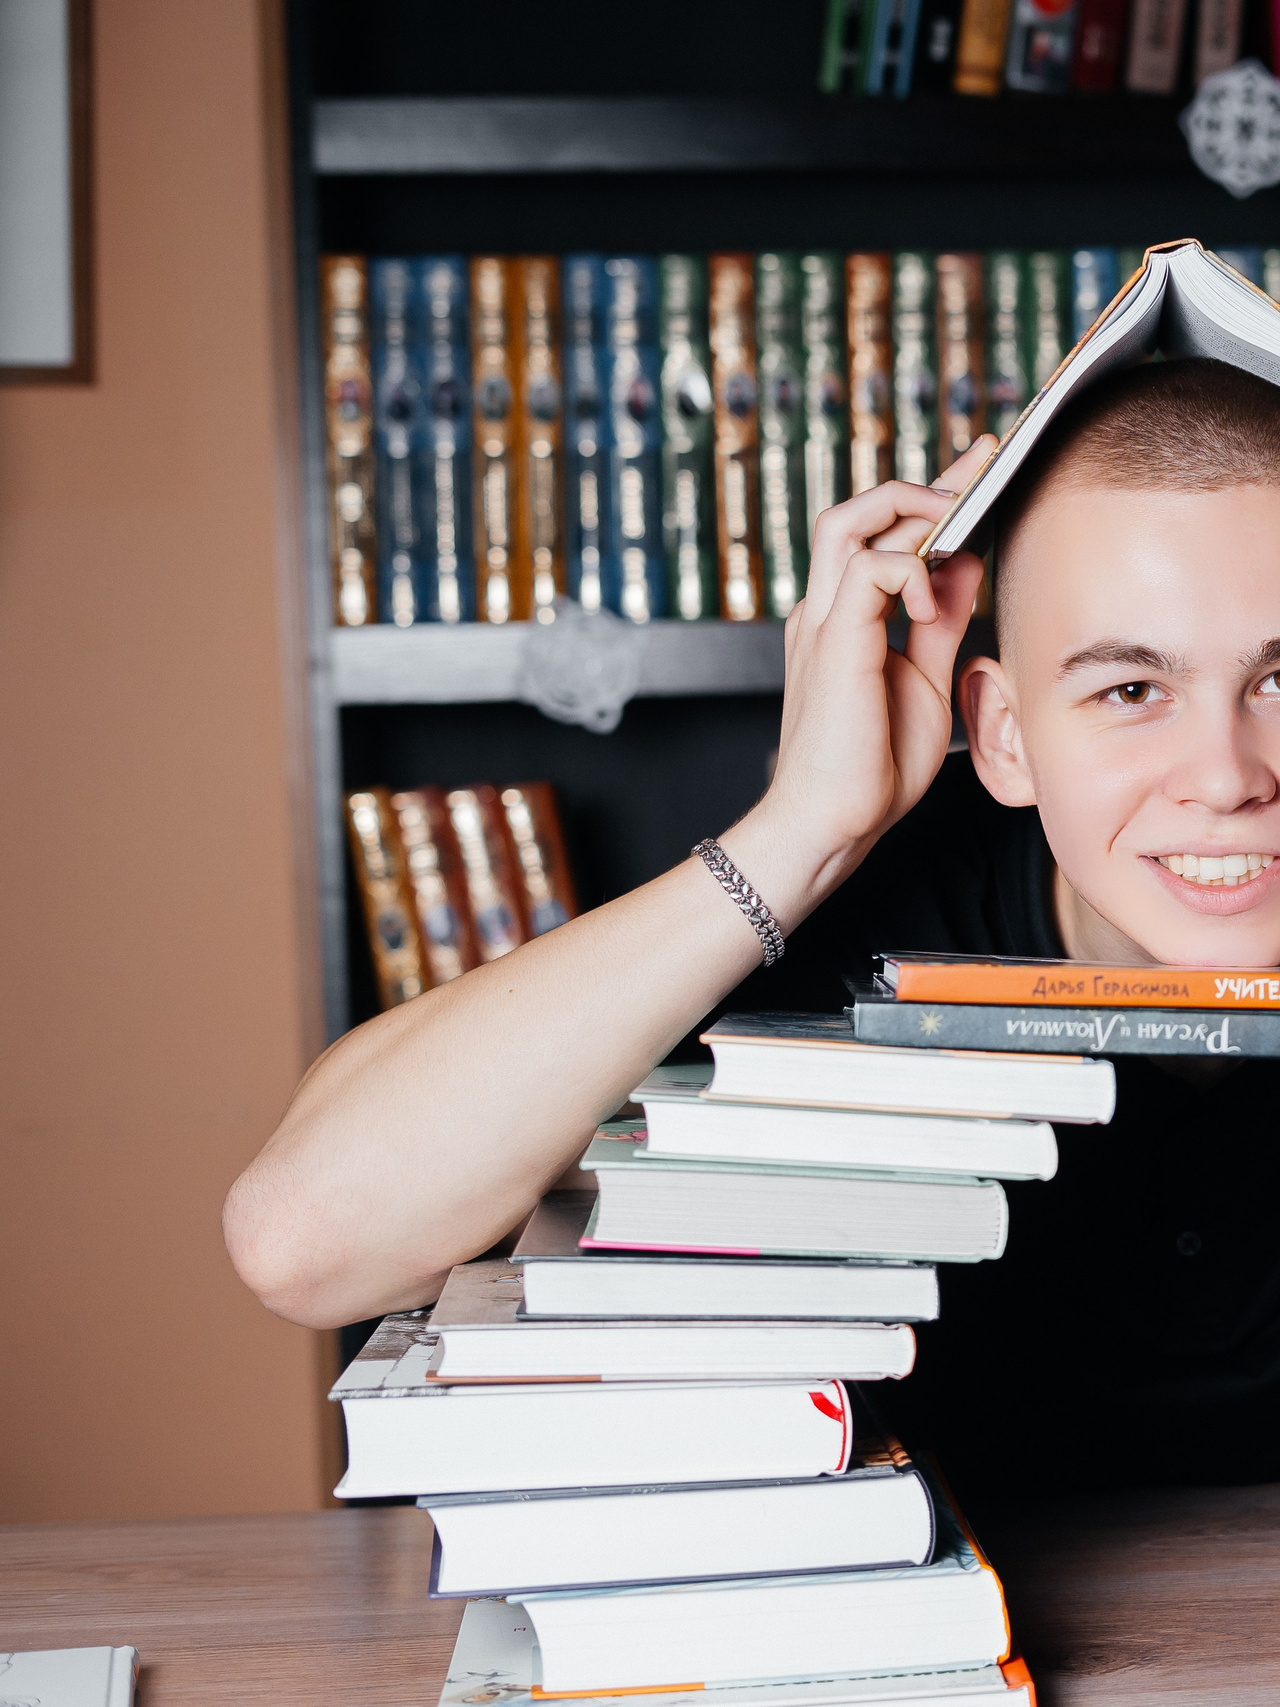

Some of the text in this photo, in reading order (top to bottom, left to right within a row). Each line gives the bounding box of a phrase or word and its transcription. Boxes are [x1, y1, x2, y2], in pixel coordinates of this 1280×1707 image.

[1006, 1013, 1242, 1054] Руслан и Людмила
